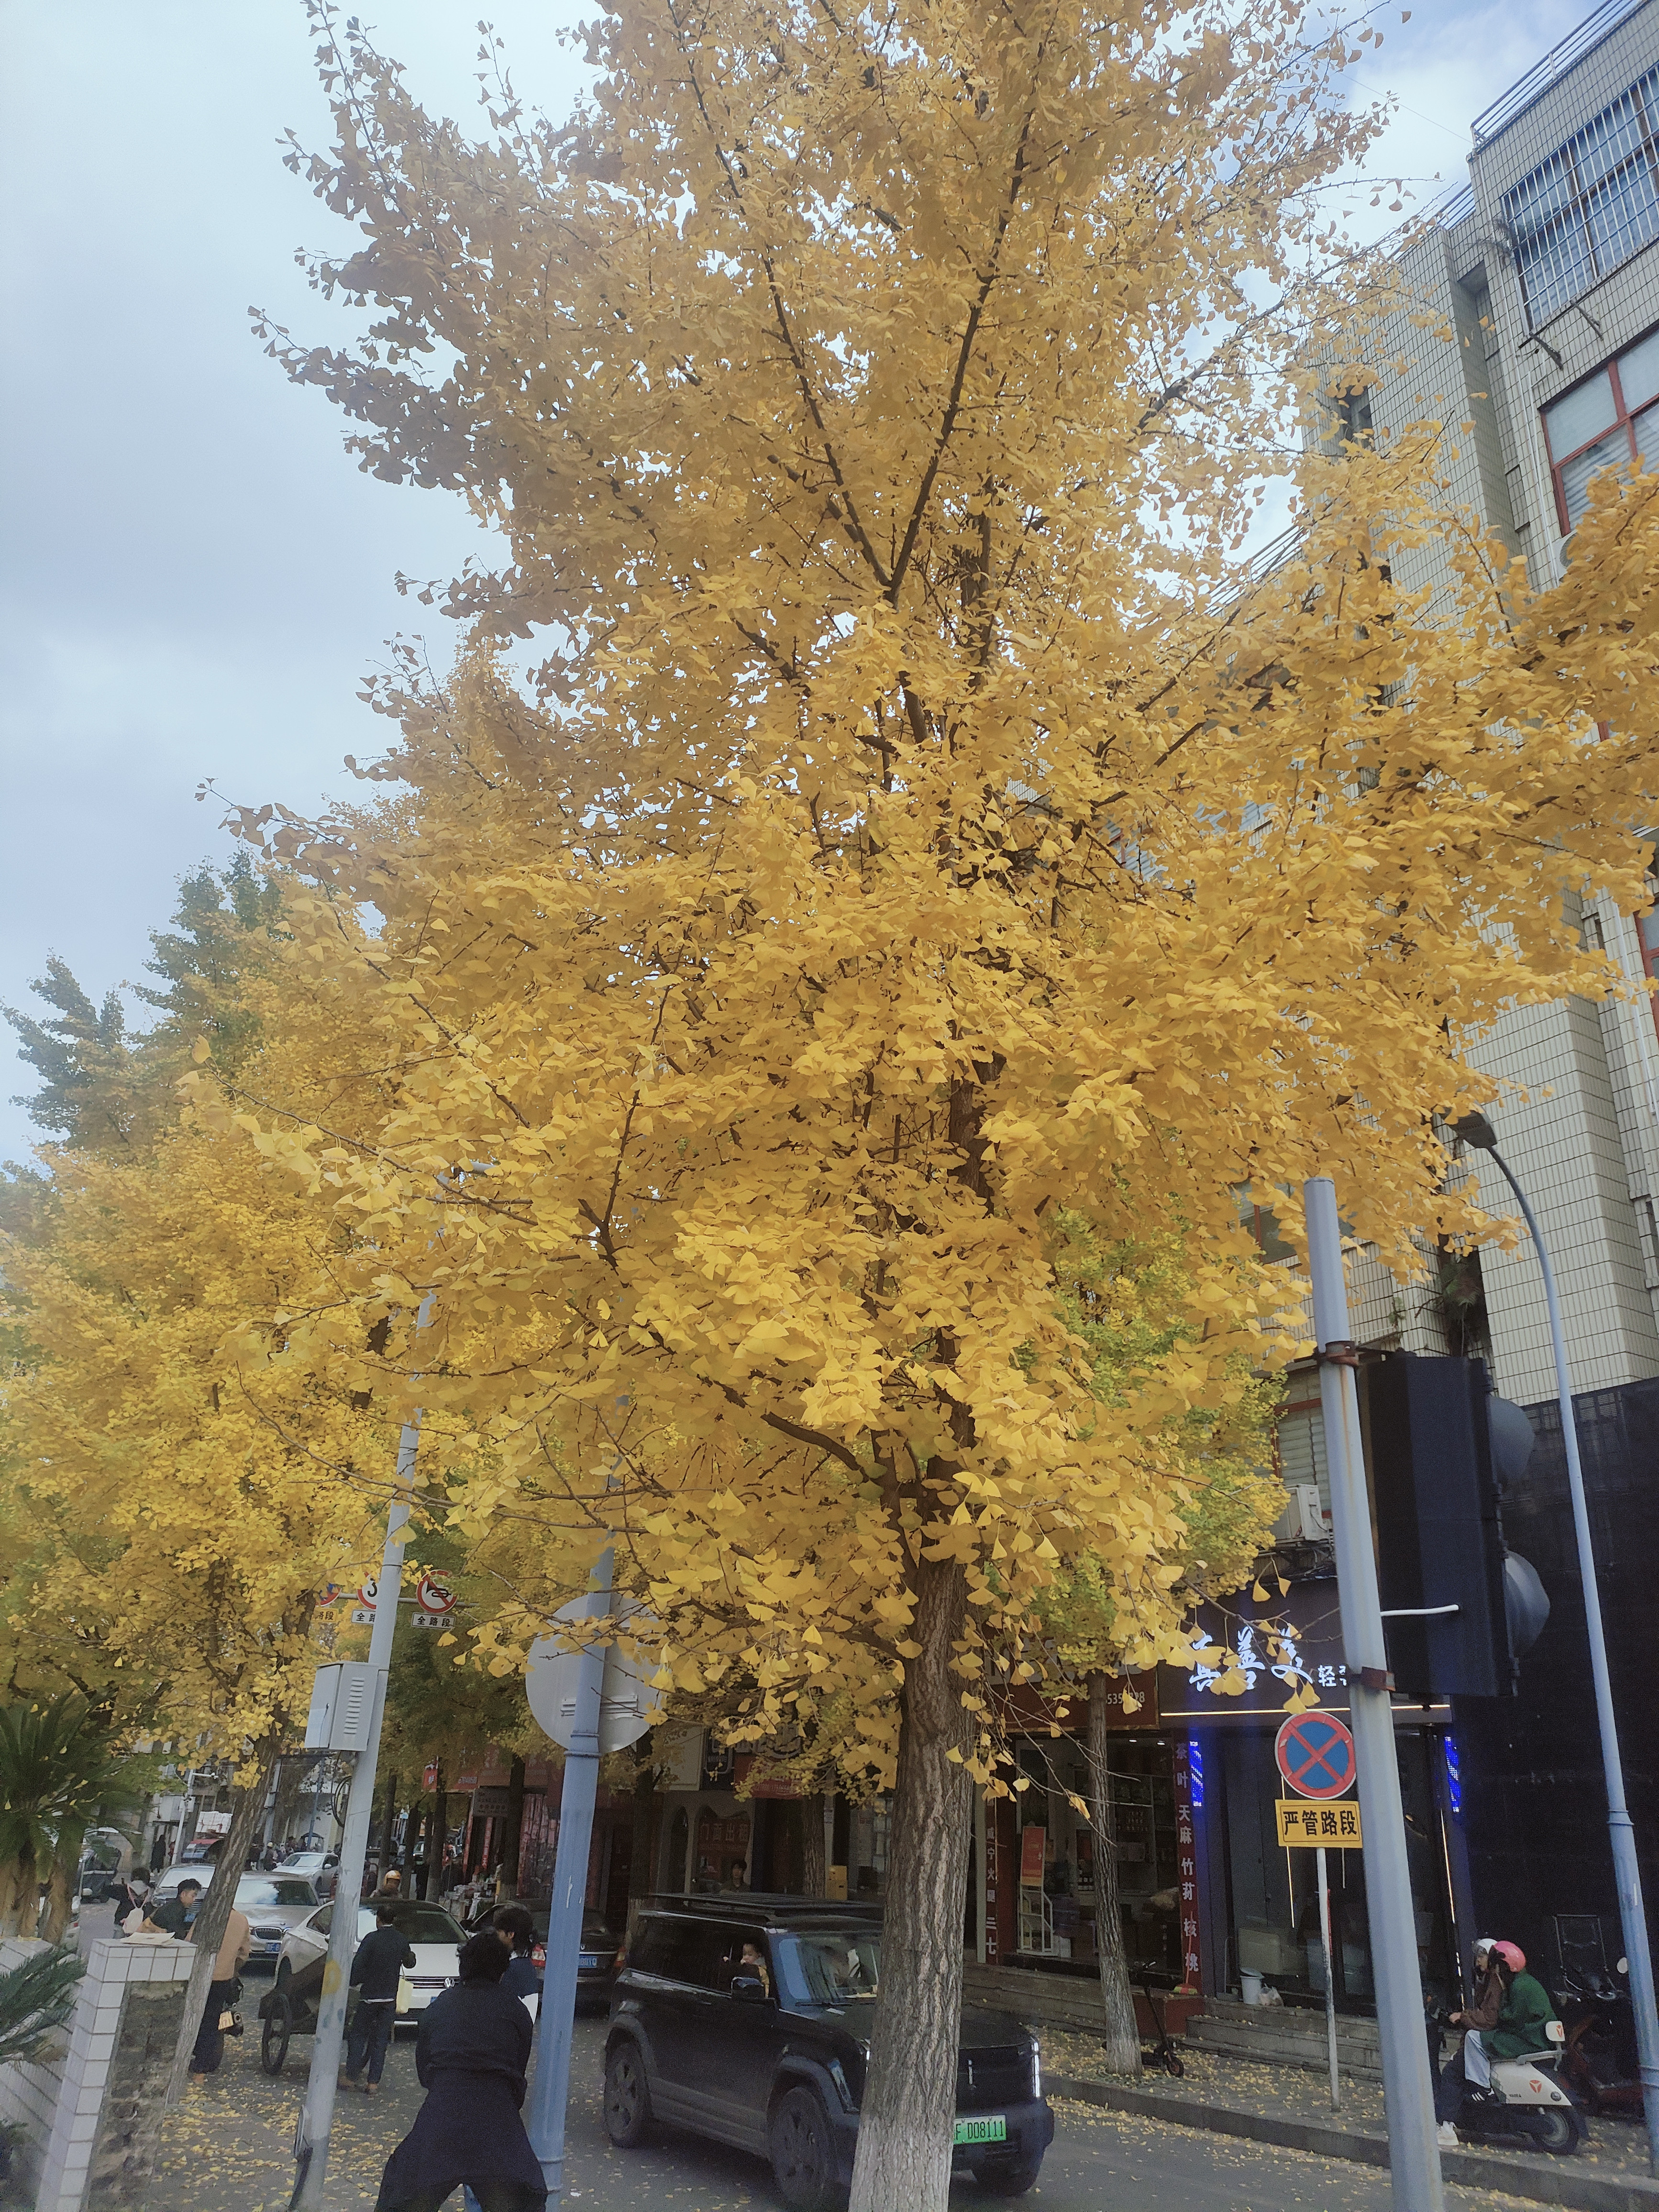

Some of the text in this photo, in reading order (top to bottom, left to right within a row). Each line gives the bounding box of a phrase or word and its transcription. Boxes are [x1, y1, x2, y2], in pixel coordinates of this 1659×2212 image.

[417, 1615, 452, 1628] 全路段
[1283, 1810, 1358, 1836] 严管路段
